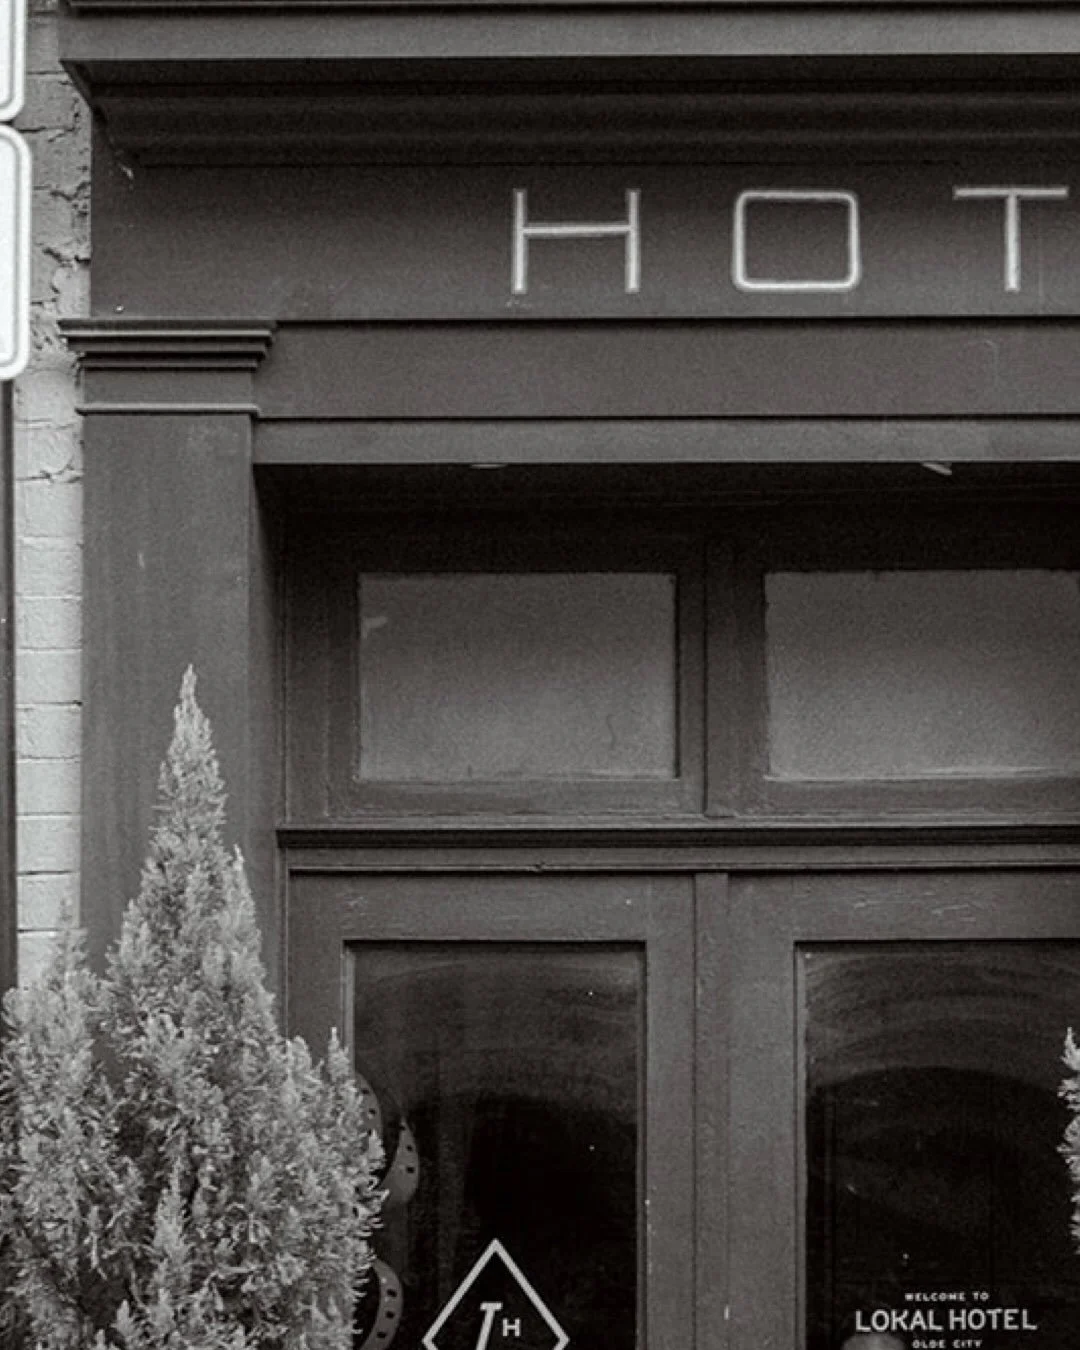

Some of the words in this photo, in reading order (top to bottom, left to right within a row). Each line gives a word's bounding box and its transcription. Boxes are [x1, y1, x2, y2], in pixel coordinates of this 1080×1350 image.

[904, 1292, 966, 1302] WELCOME
[972, 1291, 990, 1301] TO
[855, 1309, 943, 1332] LOKAL
[949, 1308, 1038, 1331] HOTEL
[911, 1339, 946, 1349] OLDE
[952, 1339, 983, 1349] CITY
